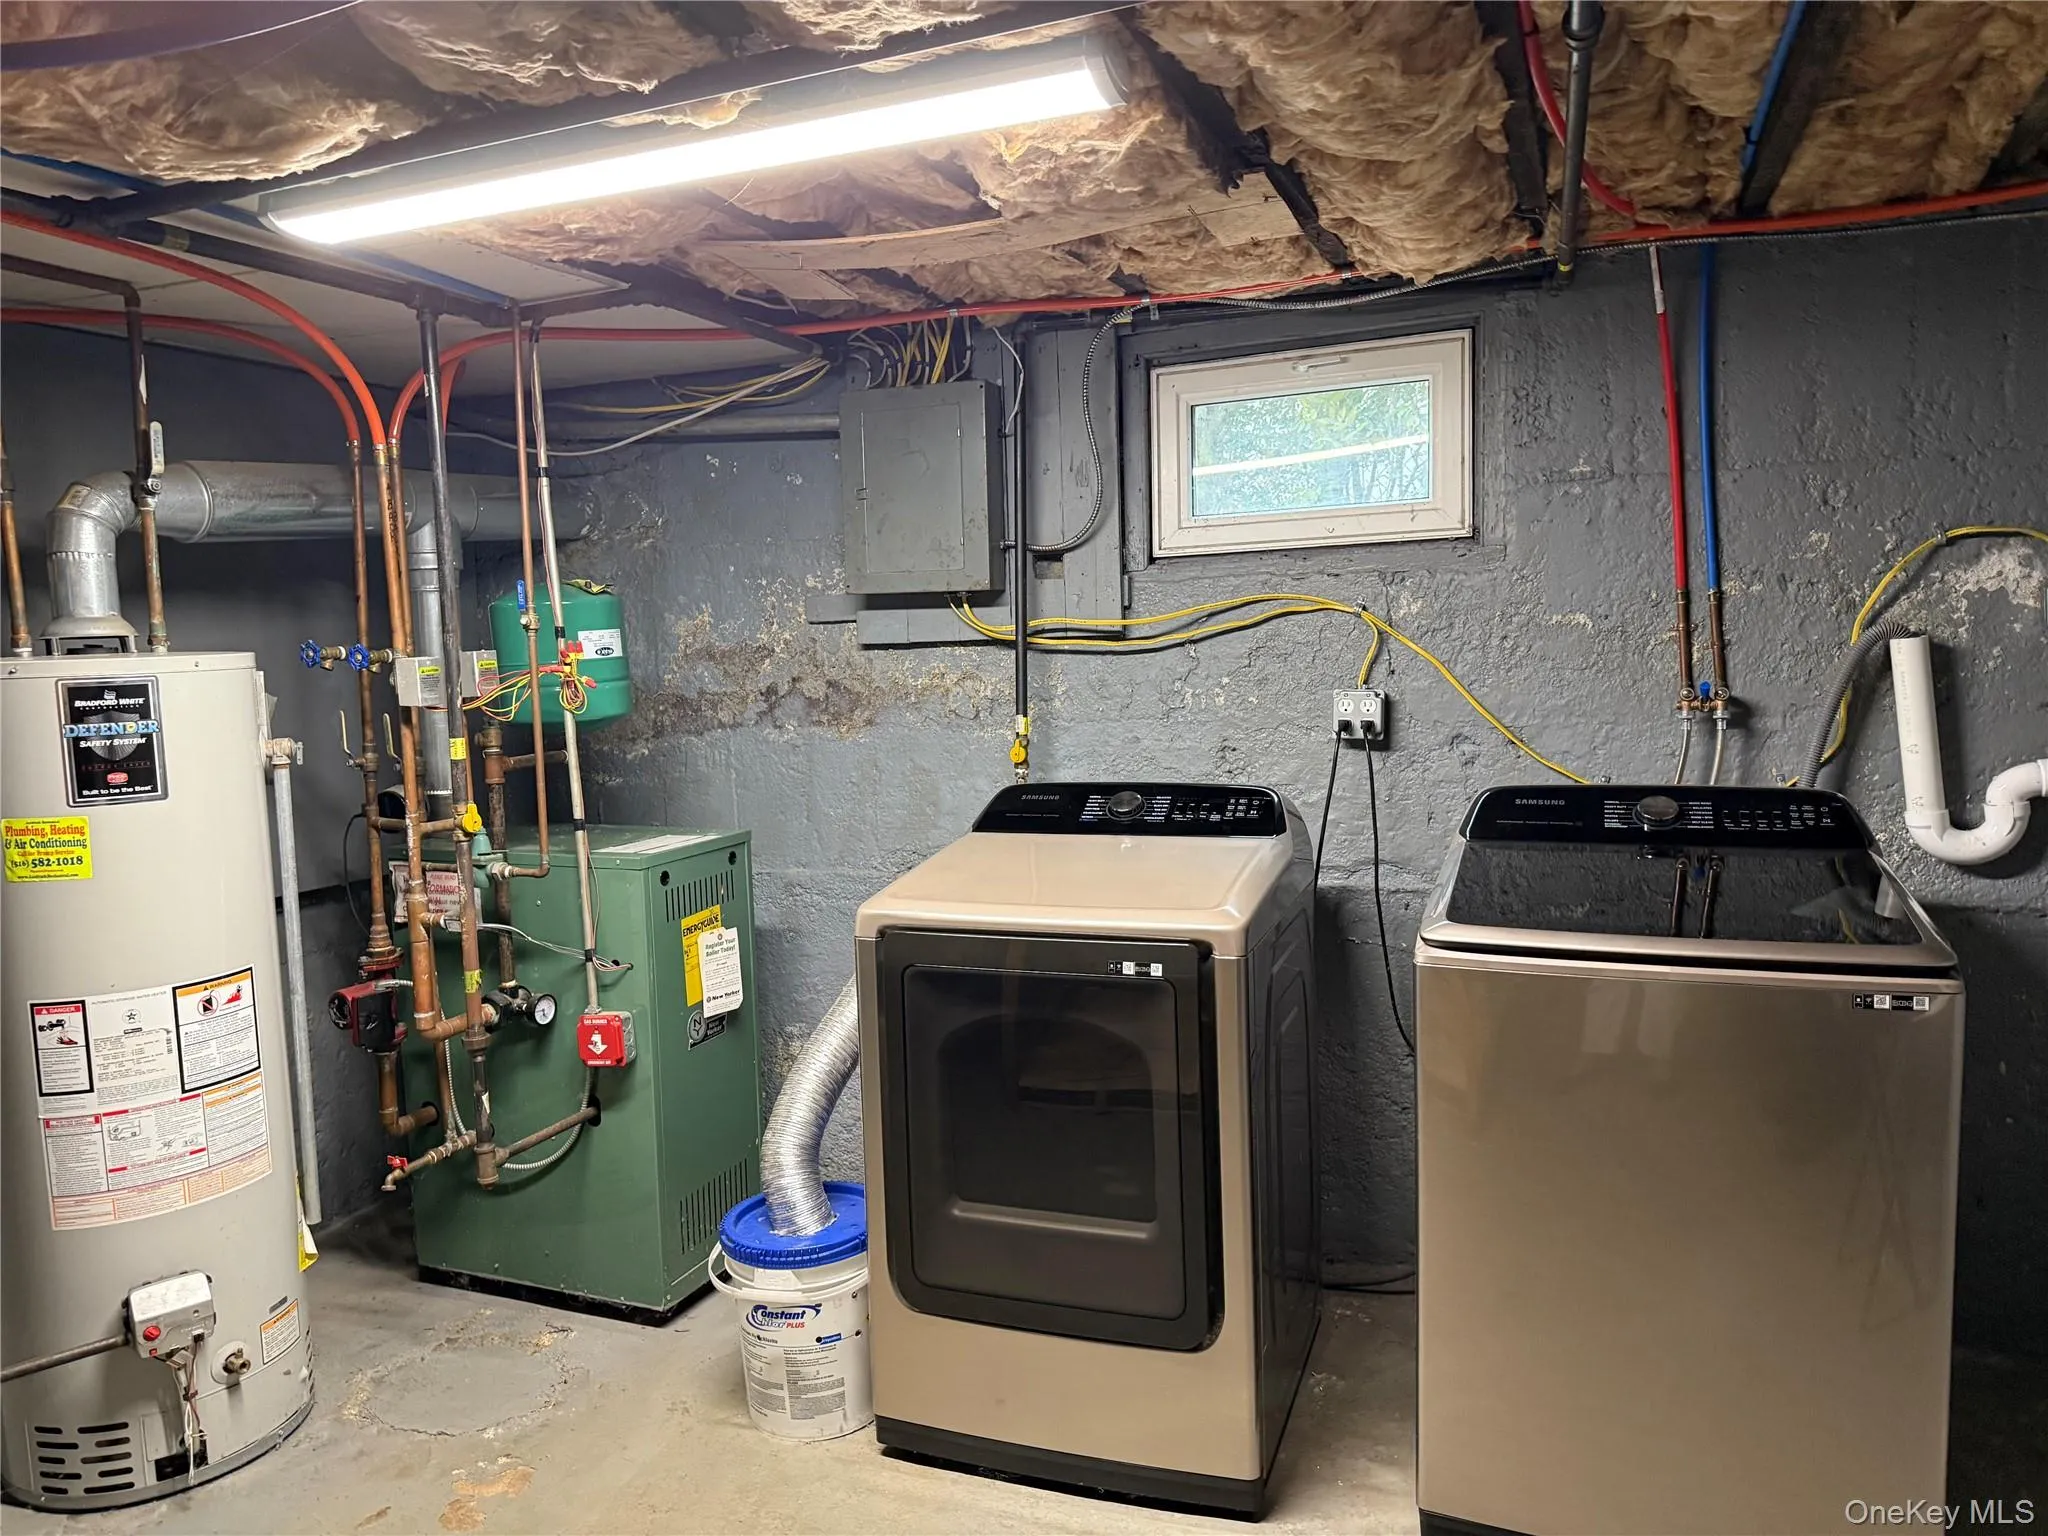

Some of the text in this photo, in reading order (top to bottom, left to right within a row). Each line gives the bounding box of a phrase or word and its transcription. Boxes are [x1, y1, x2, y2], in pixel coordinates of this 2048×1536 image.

[74, 697, 146, 707] BRADFORD WHITE
[63, 720, 160, 738] DEFENDER
[80, 737, 147, 748] SAFETY SYSTEM
[82, 788, 99, 796] Built
[1515, 798, 1566, 806] SAMSUNG
[5, 824, 86, 838] Plumbing, Heating
[4, 836, 88, 850] & Air Conditioning
[31, 855, 84, 868] 582-1018
[705, 940, 725, 950] Register
[720, 944, 736, 953] Today!
[724, 989, 740, 997] Yorker
[750, 1304, 806, 1320] Constant
[786, 1321, 806, 1329] PLUS
